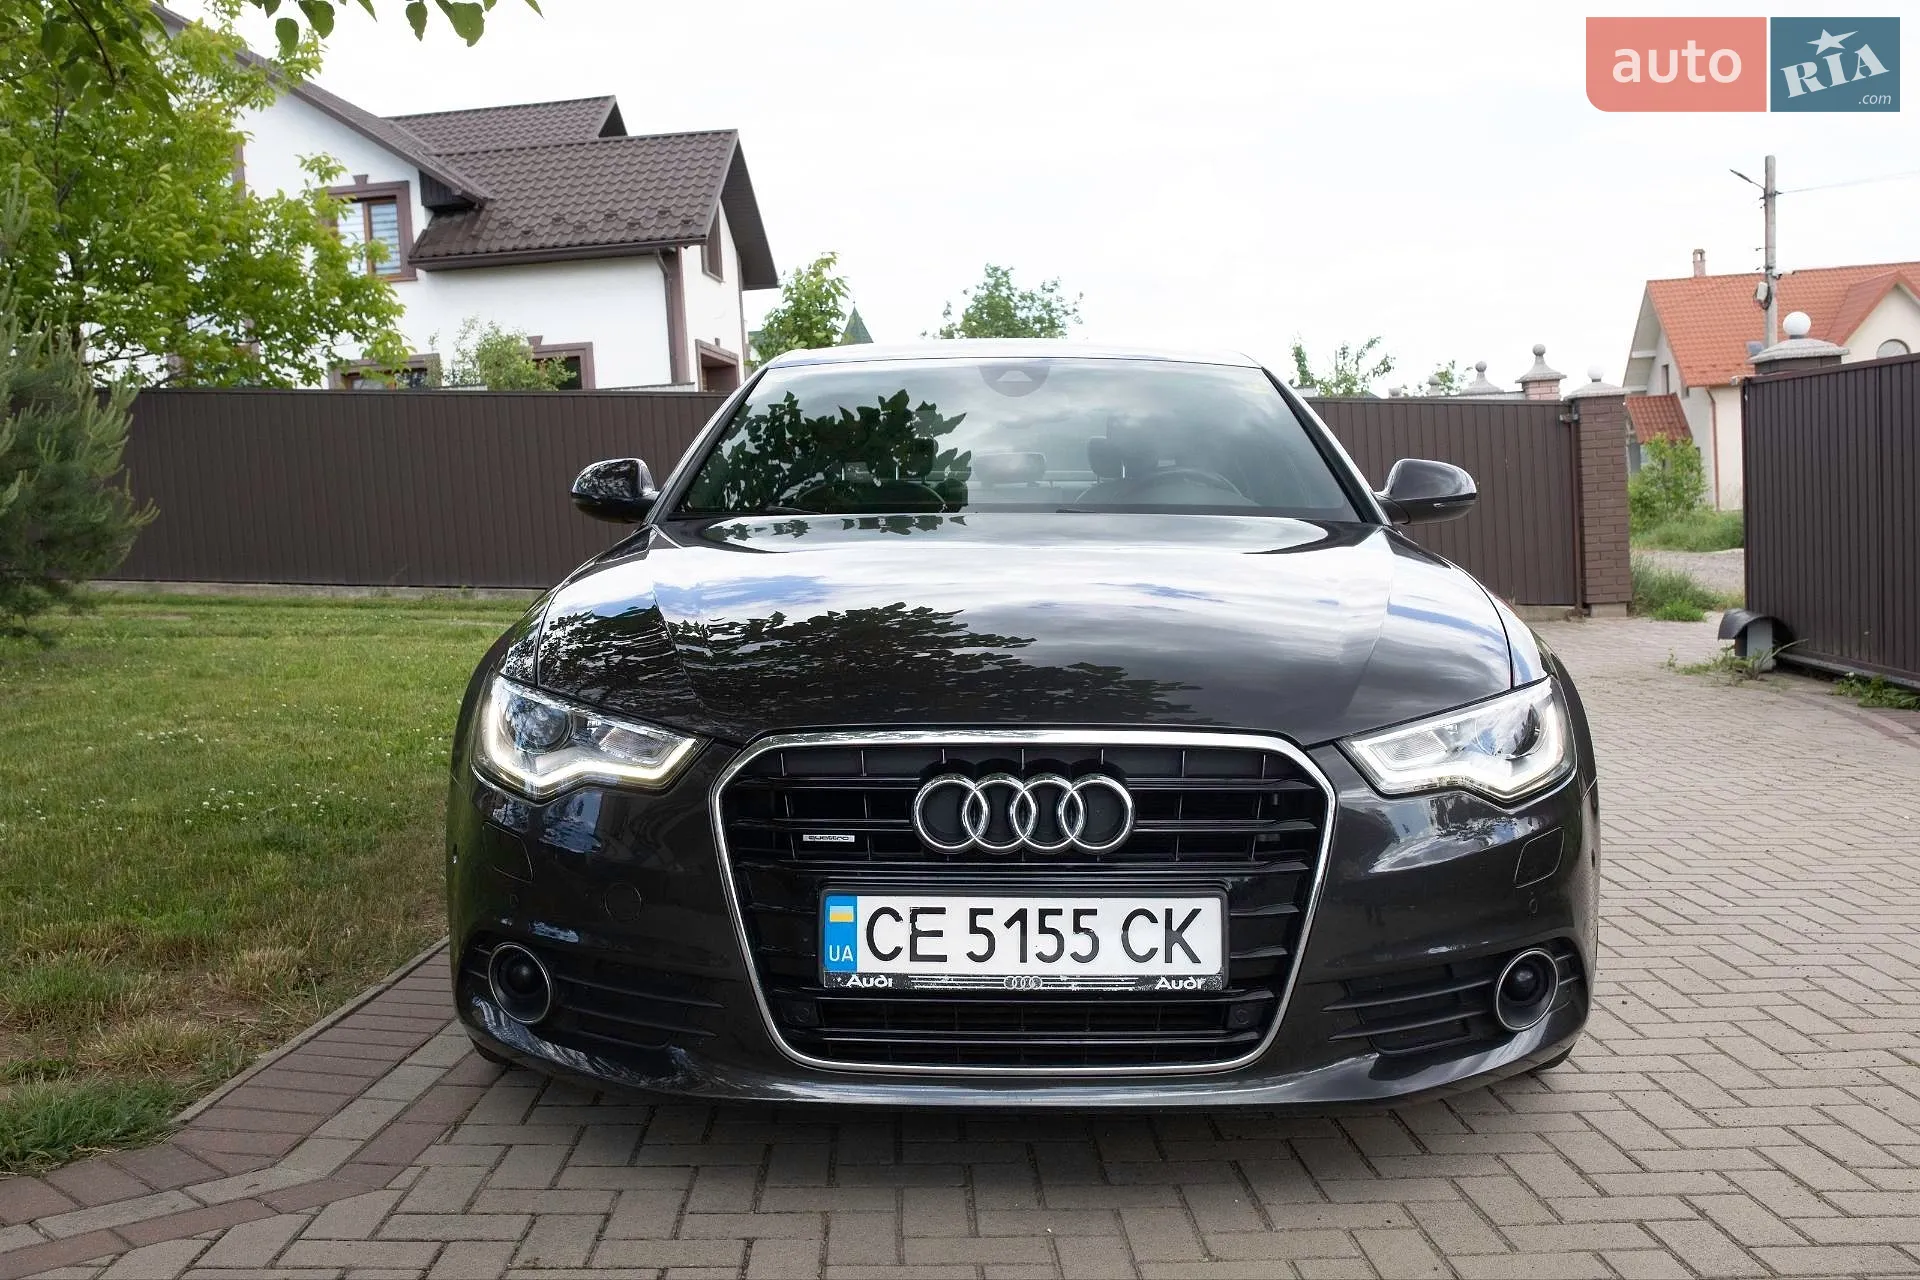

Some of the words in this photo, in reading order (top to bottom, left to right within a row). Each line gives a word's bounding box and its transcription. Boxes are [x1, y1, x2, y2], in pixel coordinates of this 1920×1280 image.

[866, 907, 947, 962] CE
[966, 908, 1100, 963] 5155
[1121, 908, 1202, 964] CK
[829, 945, 853, 962] UA
[846, 974, 893, 988] Audi
